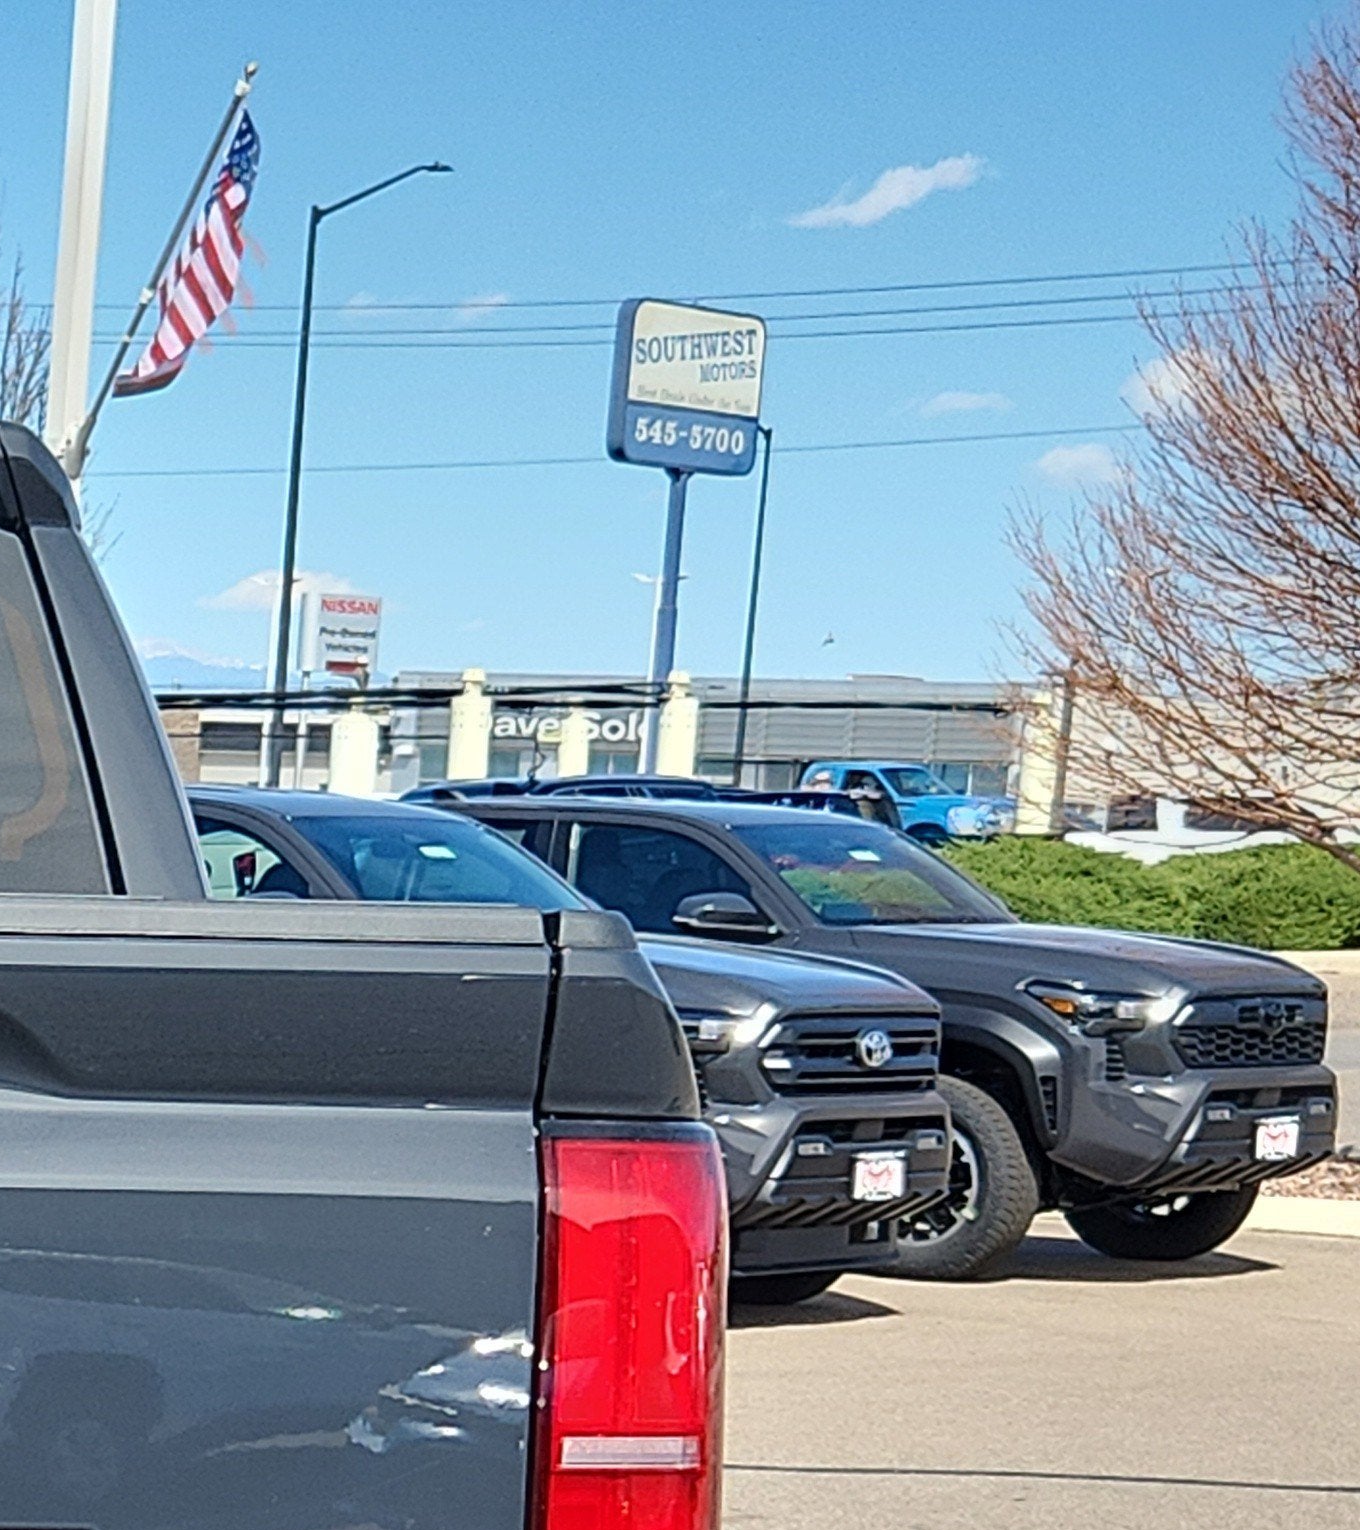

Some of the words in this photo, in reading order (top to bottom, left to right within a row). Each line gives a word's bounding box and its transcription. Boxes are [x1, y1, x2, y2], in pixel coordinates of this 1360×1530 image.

[635, 329, 757, 364] SOUTHWEST
[699, 360, 757, 383] MOTORS
[634, 417, 745, 455] 545-5700
[320, 599, 379, 615] NISSAN
[488, 714, 561, 738] ave
[580, 711, 644, 742] Sol
